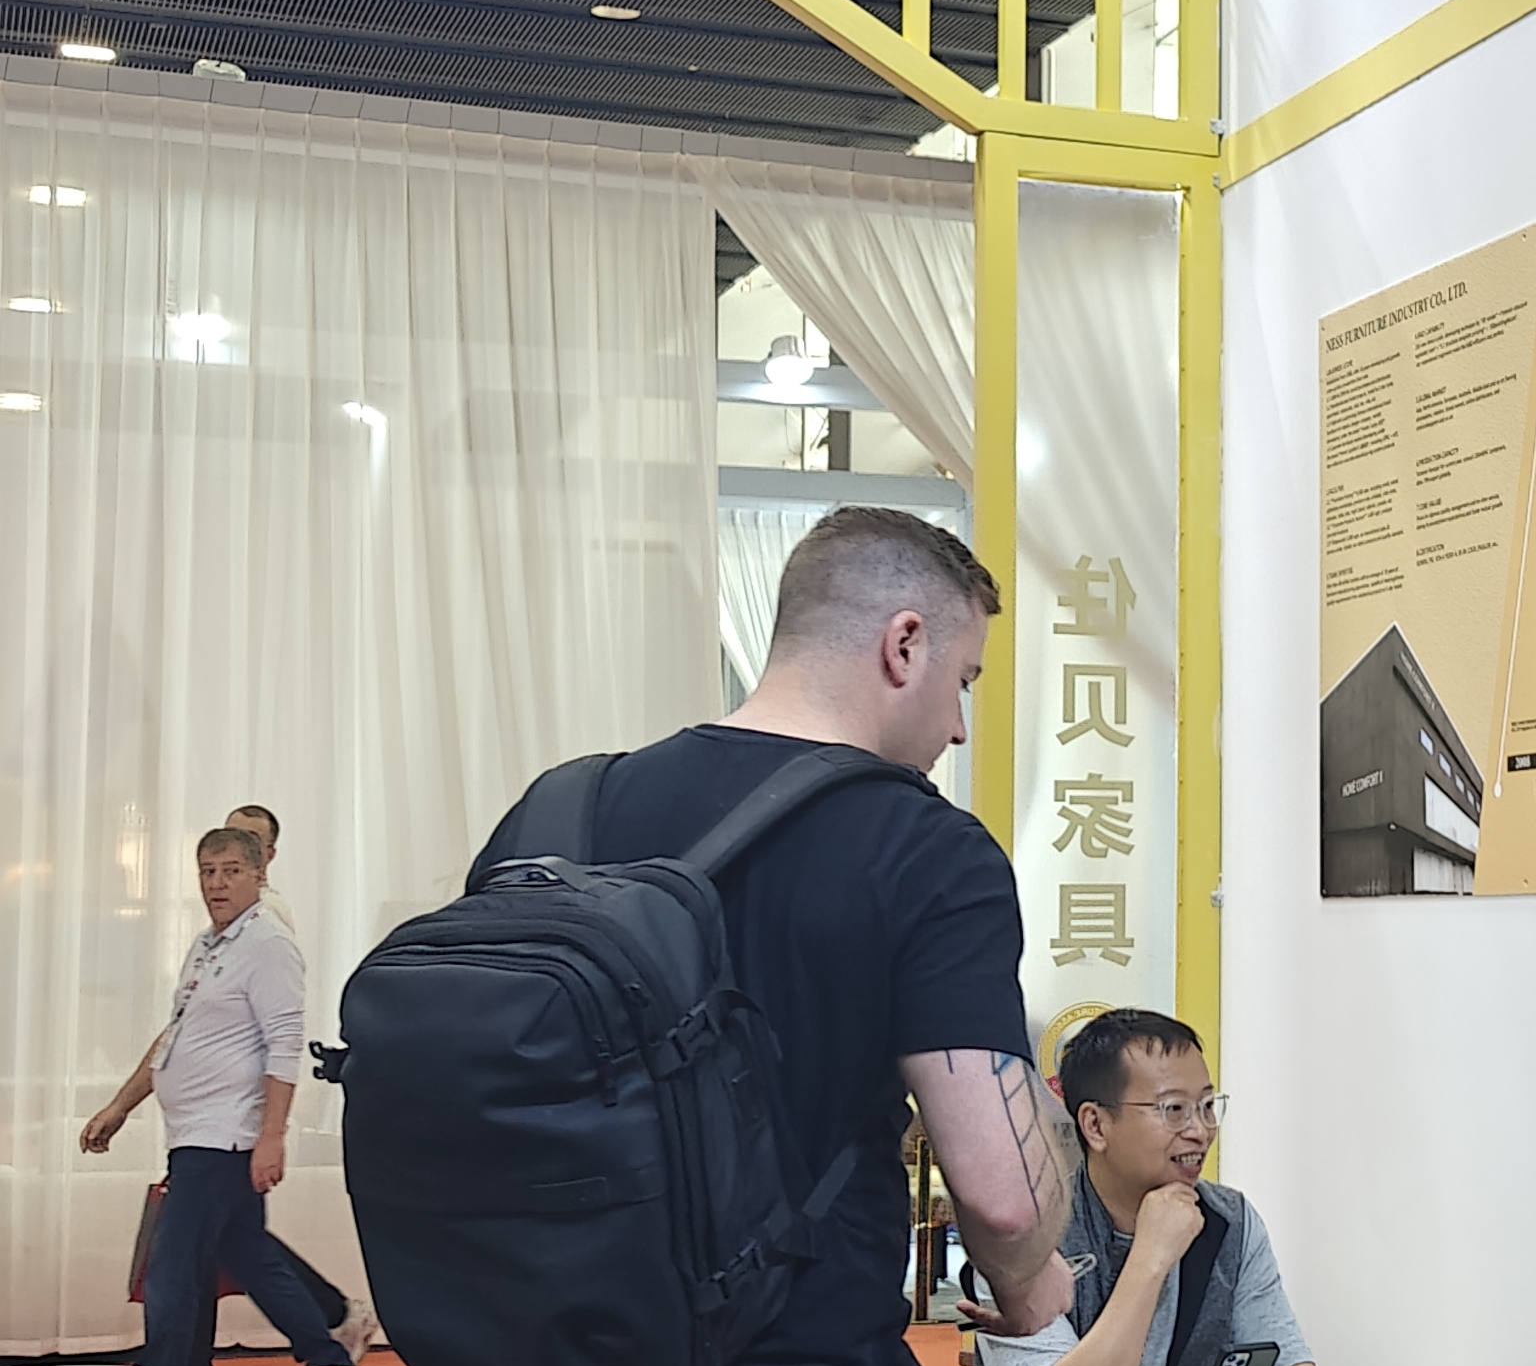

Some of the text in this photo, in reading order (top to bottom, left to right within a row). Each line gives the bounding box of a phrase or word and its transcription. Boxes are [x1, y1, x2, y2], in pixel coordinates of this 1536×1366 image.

[1326, 336, 1344, 353] NESS
[1344, 314, 1389, 346] FURNITURE
[1388, 296, 1430, 327] INDUSTRY
